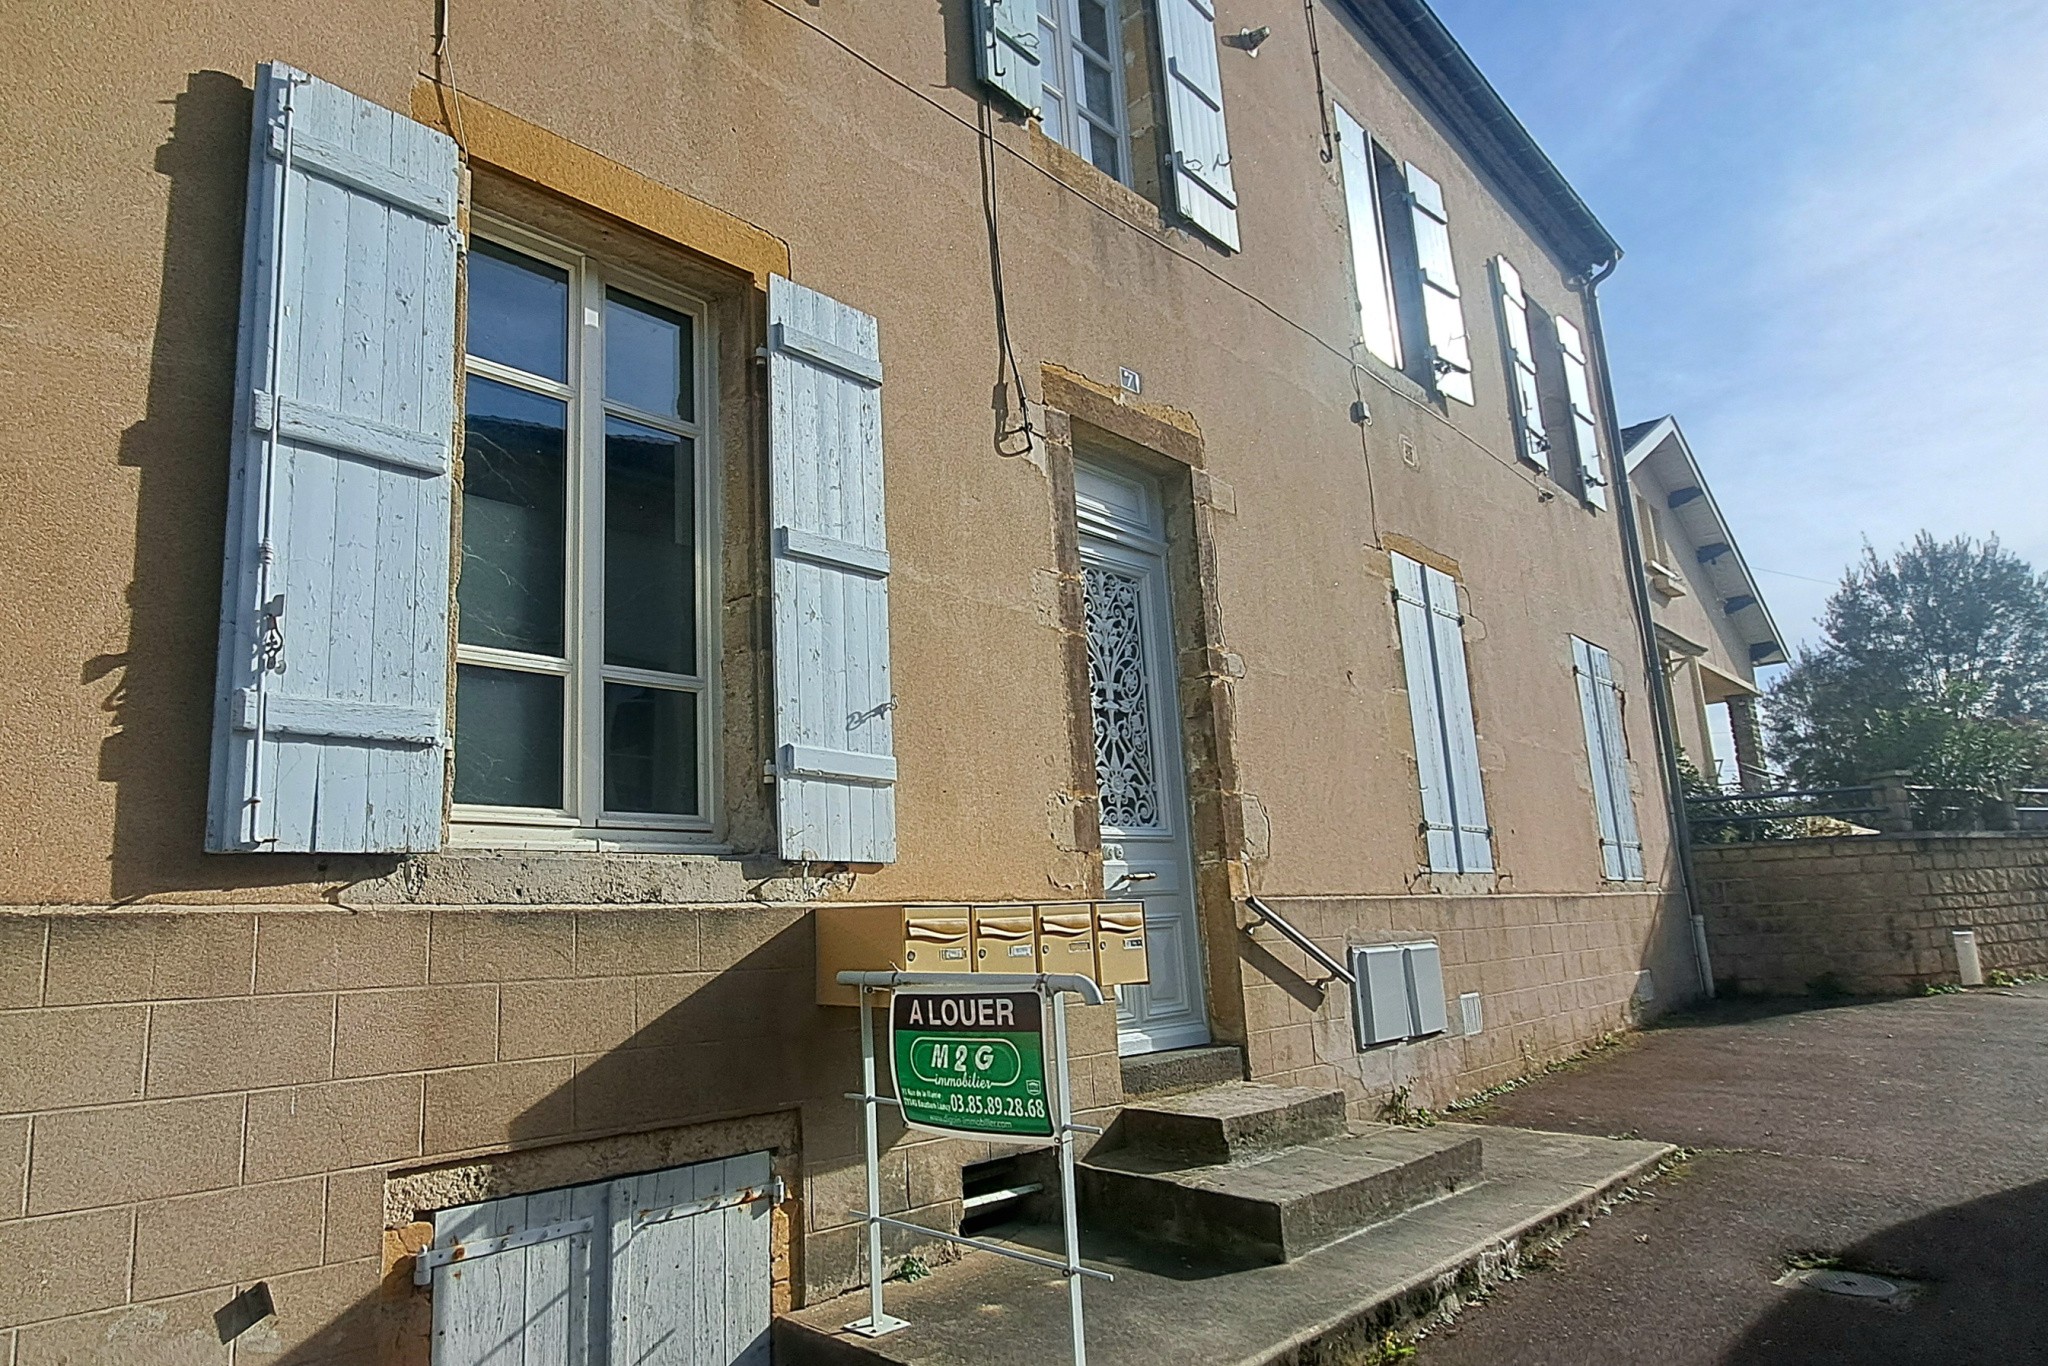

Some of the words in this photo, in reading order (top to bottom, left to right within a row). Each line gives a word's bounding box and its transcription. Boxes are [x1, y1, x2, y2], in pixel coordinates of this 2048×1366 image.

[1124, 371, 1134, 387] 7
[909, 999, 923, 1025] A
[928, 998, 1014, 1026] LOUER
[934, 1072, 993, 1089] immobilier
[950, 1093, 1045, 1118] 03.85.89.28.68
